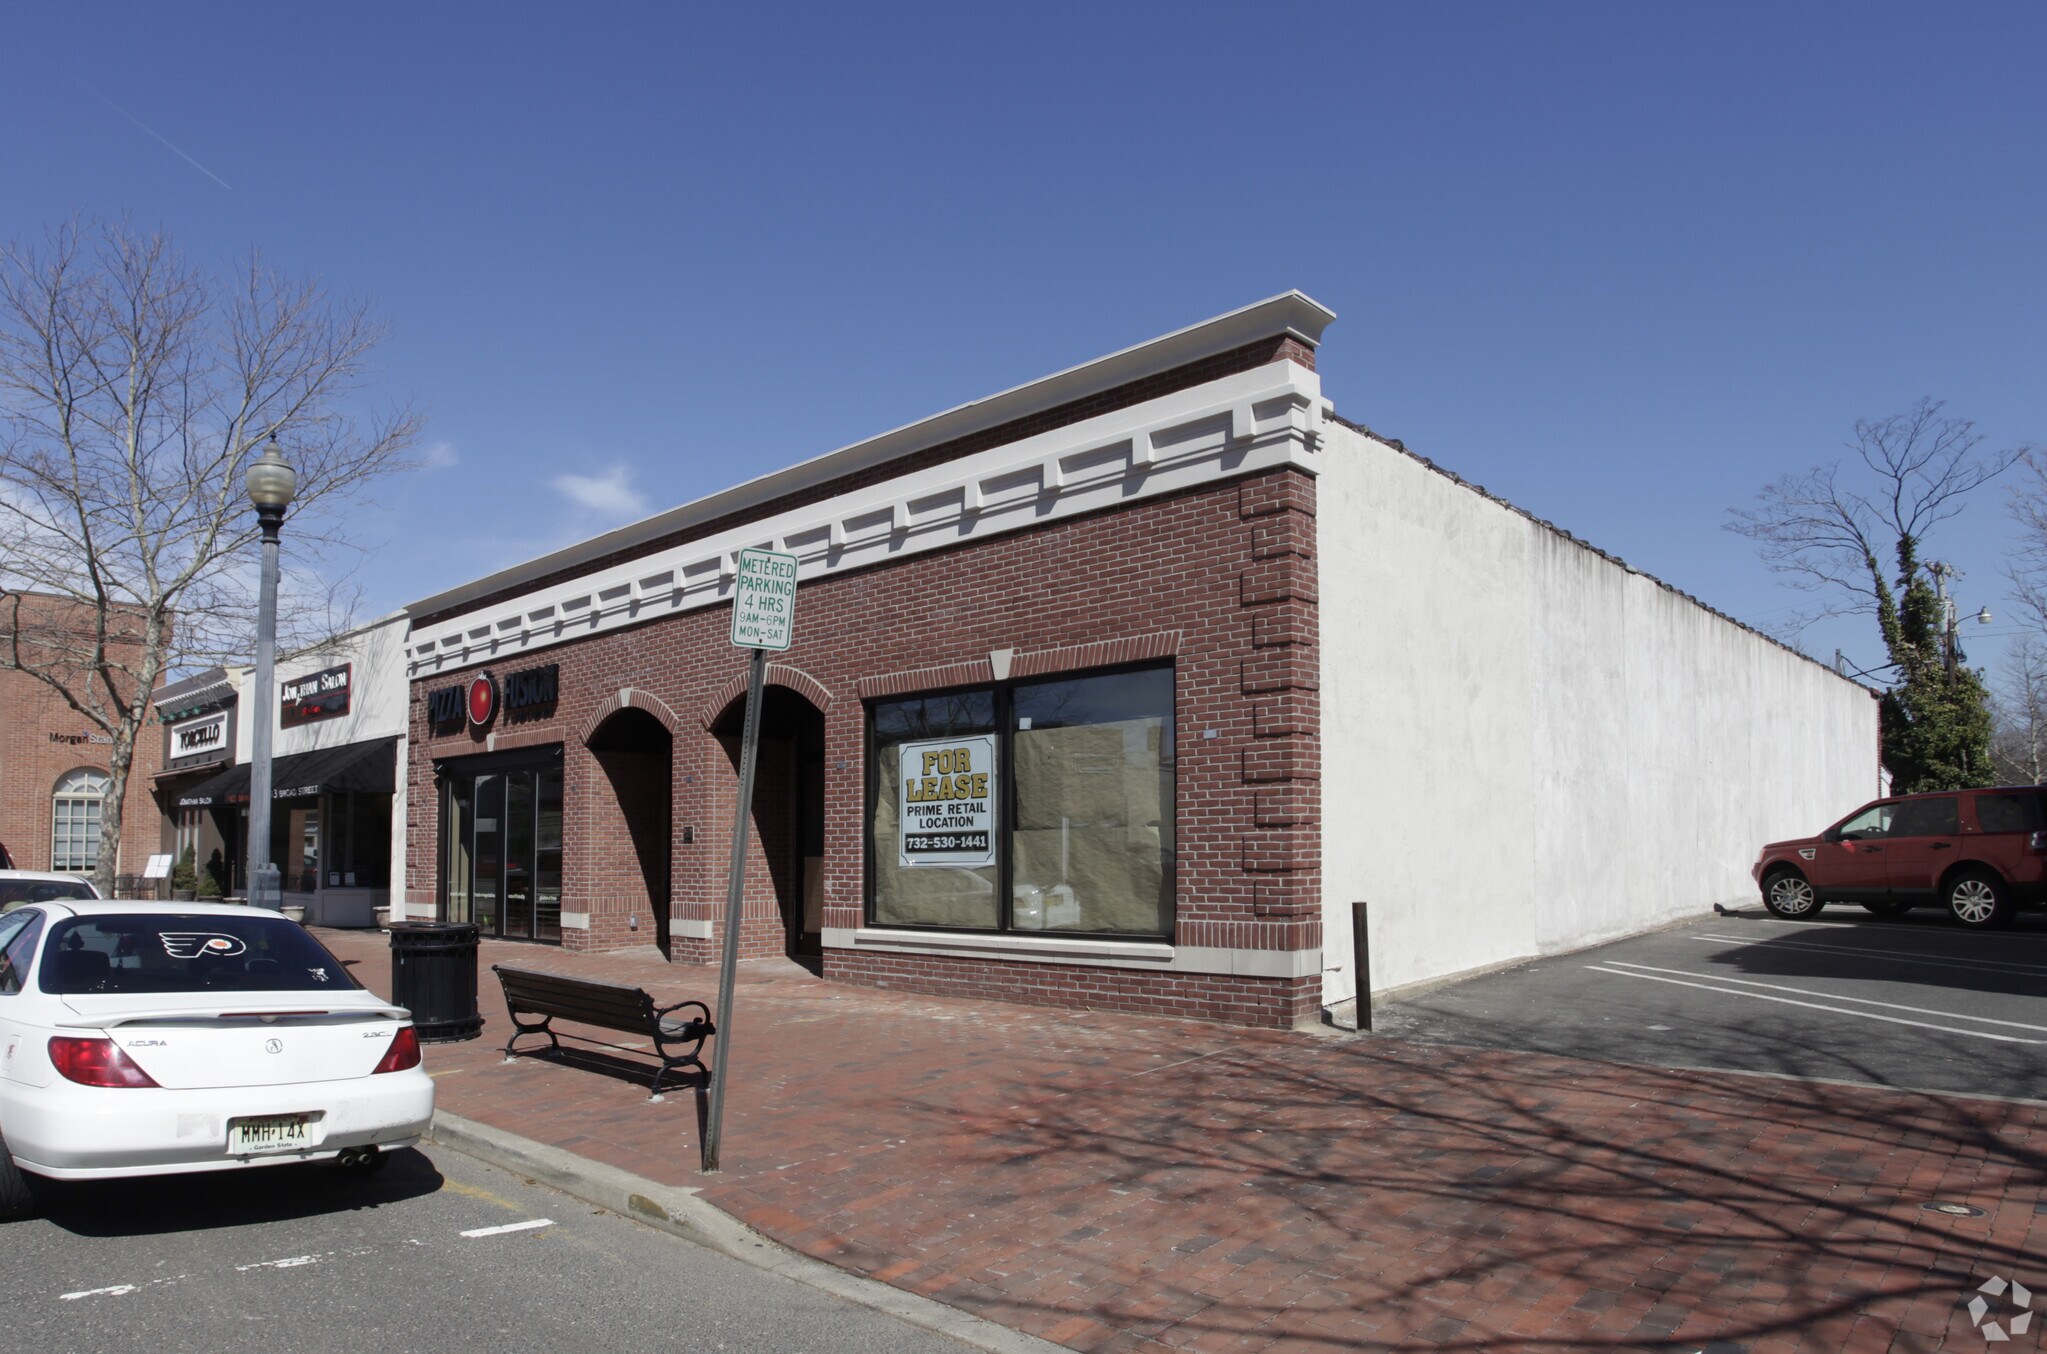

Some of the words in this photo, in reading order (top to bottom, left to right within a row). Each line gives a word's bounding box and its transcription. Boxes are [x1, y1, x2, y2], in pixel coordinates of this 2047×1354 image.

[742, 558, 794, 578] METERED
[741, 576, 792, 596] PARKING
[745, 594, 753, 609] 4
[759, 596, 784, 612] HRS
[740, 612, 785, 626] 9AM-6PM
[739, 626, 783, 640] MON-SAT
[321, 672, 347, 690] SALON
[428, 685, 464, 723] PIZZA
[503, 664, 558, 709] FUSION
[49, 732, 89, 745] Morgan
[90, 733, 114, 745] Stan
[922, 748, 971, 776] FOR
[278, 788, 297, 798] BROAD
[298, 785, 318, 796] STREET
[906, 773, 988, 803] LEASE
[907, 805, 943, 817] PRIME
[948, 802, 986, 815] RETAIL
[919, 816, 974, 829] LOCATION
[906, 835, 986, 849] 732-530-1441
